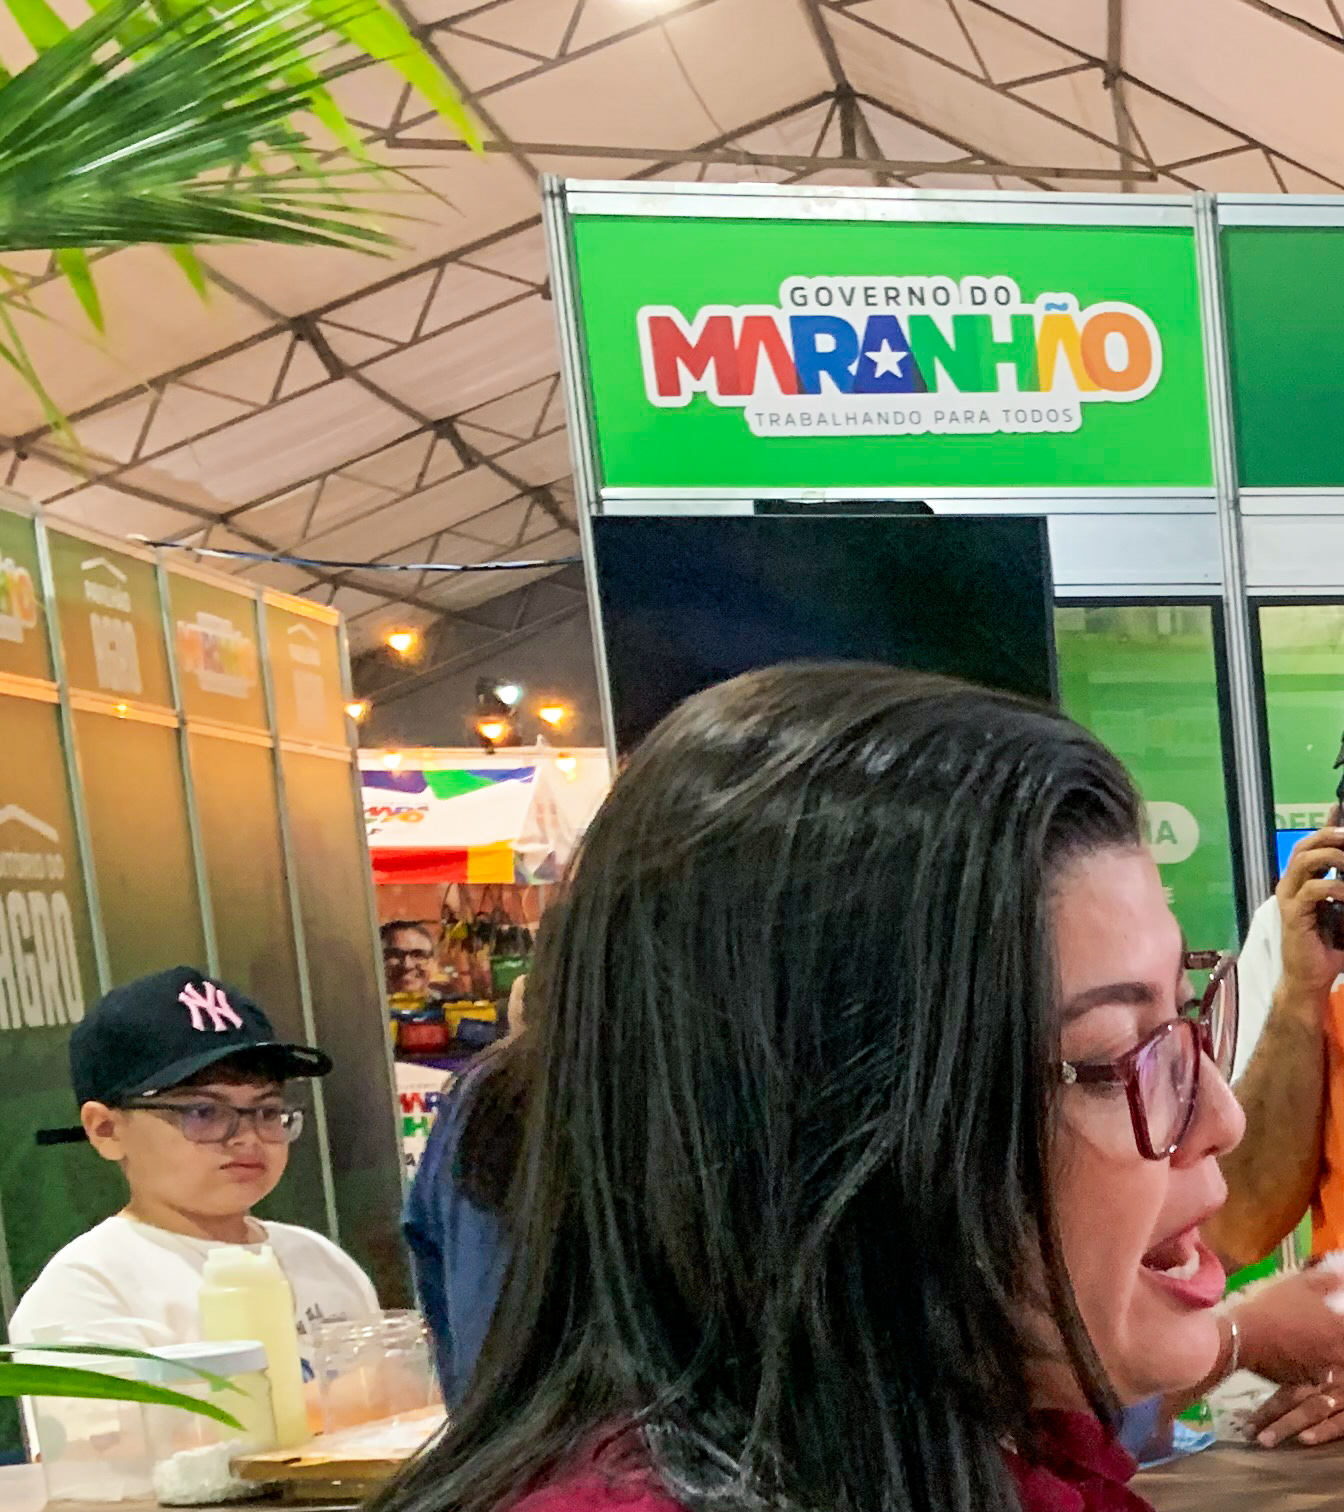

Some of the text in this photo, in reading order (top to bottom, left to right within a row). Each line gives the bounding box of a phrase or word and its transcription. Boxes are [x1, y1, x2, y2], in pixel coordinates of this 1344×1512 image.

[789, 284, 1012, 308] GOVERNO DO
[647, 301, 1153, 397] MARANHÃO
[754, 407, 1074, 428] TRABALHANDO PARA TODOS
